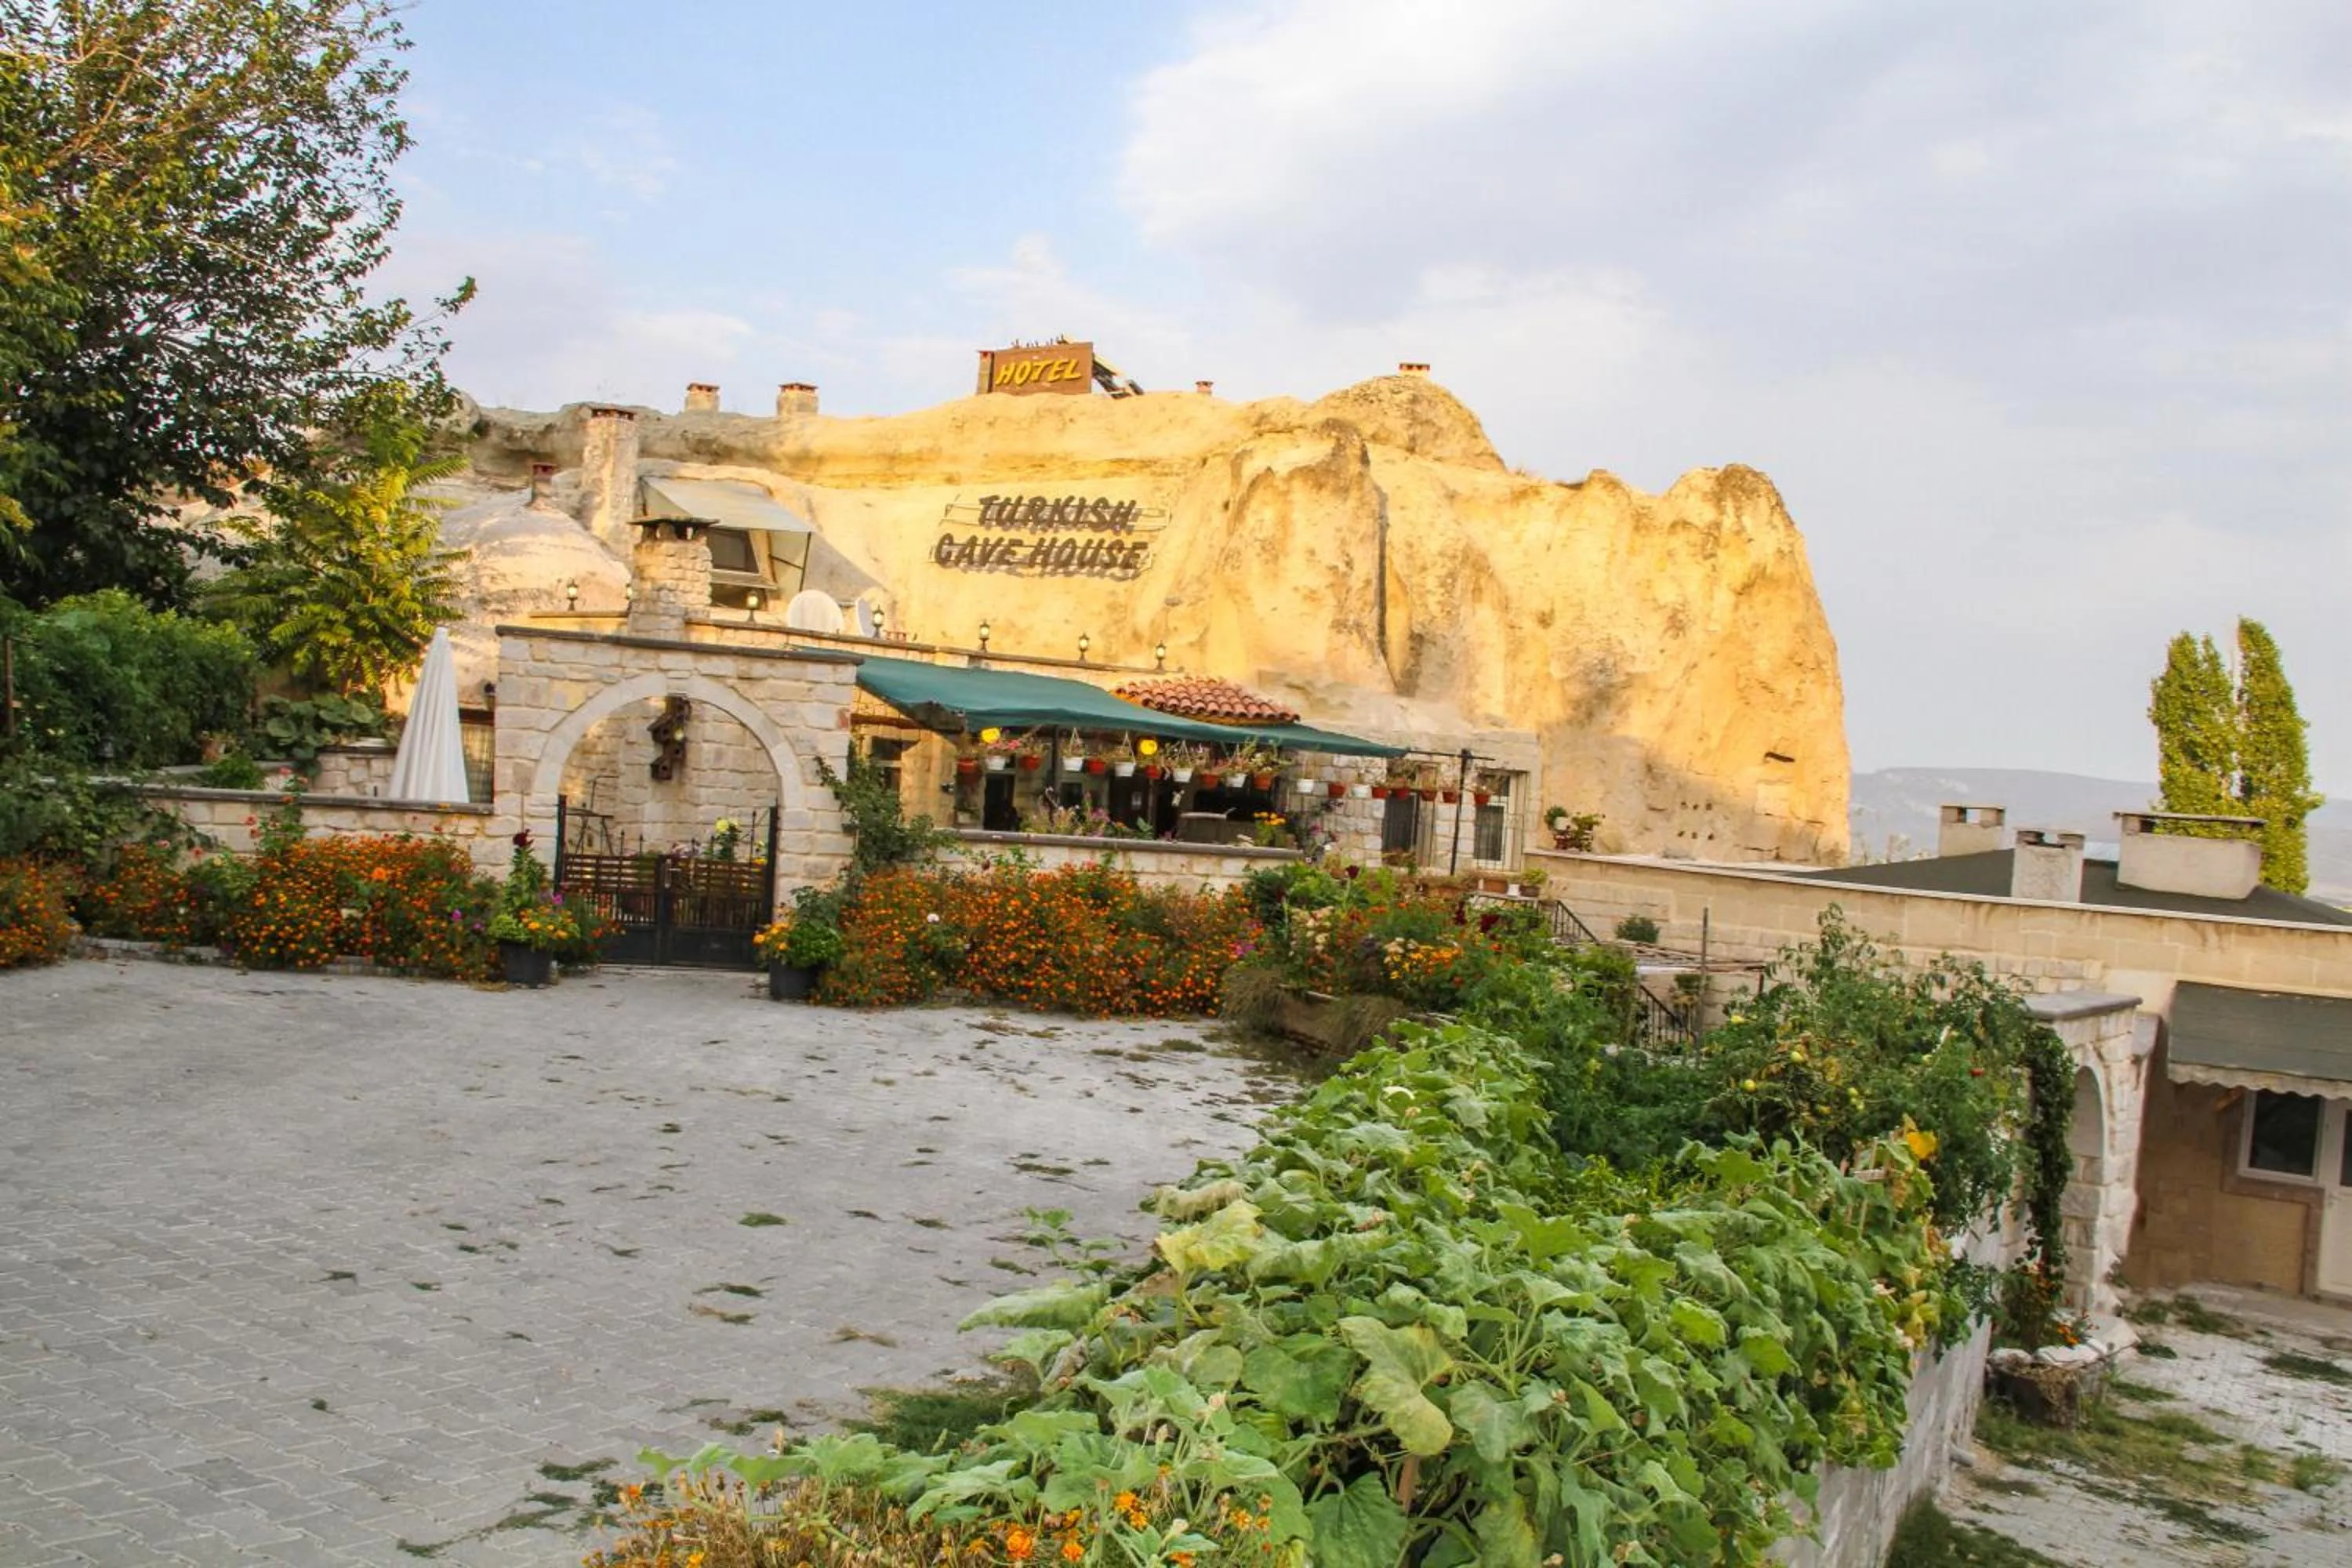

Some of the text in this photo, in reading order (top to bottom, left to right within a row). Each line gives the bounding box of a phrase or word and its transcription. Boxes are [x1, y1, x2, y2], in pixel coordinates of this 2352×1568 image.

[995, 358, 1080, 386] HOTEL
[978, 495, 1137, 532] TURKISH
[935, 533, 1149, 569] CAVE HOUSE
